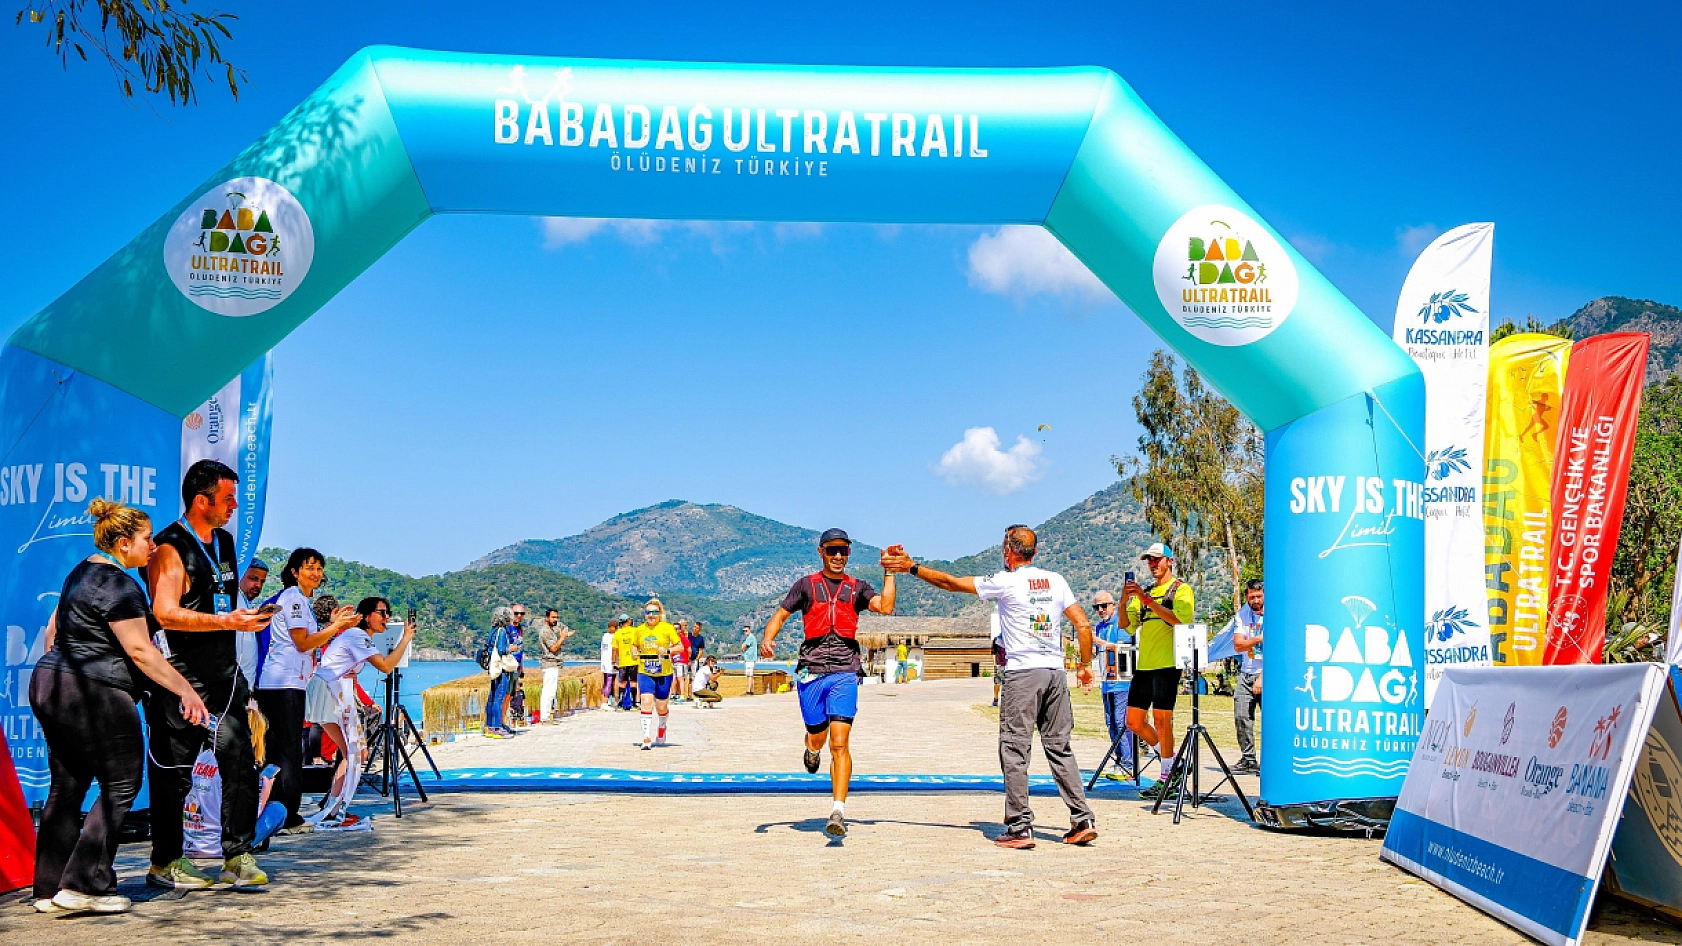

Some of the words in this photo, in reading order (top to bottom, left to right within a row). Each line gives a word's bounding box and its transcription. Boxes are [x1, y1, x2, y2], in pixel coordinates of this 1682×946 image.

[494, 98, 711, 150] BABADAĞ
[723, 107, 989, 157] ULTRATRAIL
[610, 151, 722, 175] ÖLÜDENİZ
[734, 154, 829, 177] TÜRKİYE
[201, 207, 274, 233] BABA
[191, 255, 284, 276] ULTRATRAIL
[1188, 237, 1260, 262] BABA
[1182, 288, 1272, 303] ULTRATRAIL
[1406, 328, 1483, 345] KASSANDRA
[1569, 426, 1590, 453] VE
[0, 463, 43, 506] SKY
[54, 462, 88, 503] IS
[100, 463, 157, 506] THE
[237, 402, 257, 565] www.oludenizbeach.tr
[1584, 415, 1614, 529] BAKANLIĞI
[1290, 475, 1346, 514] SKY
[1355, 476, 1384, 514] IS
[1393, 479, 1424, 520] THE
[1424, 486, 1476, 503] SSANDRA
[1560, 457, 1586, 546] GENÇLİK
[18, 499, 97, 553] Limi
[1318, 507, 1395, 558] Limit
[1555, 553, 1574, 587] T.C.
[1579, 534, 1600, 588] SPOR
[1028, 578, 1051, 590] TEAM
[1512, 507, 1548, 652] ULTRATRAIL
[1305, 624, 1412, 667] BABA
[1295, 707, 1421, 736] ULTRATRAIL
[1293, 734, 1367, 751] ÖLÜDENİZ
[1525, 755, 1564, 791] Orange
[1566, 763, 1610, 799] BANANA
